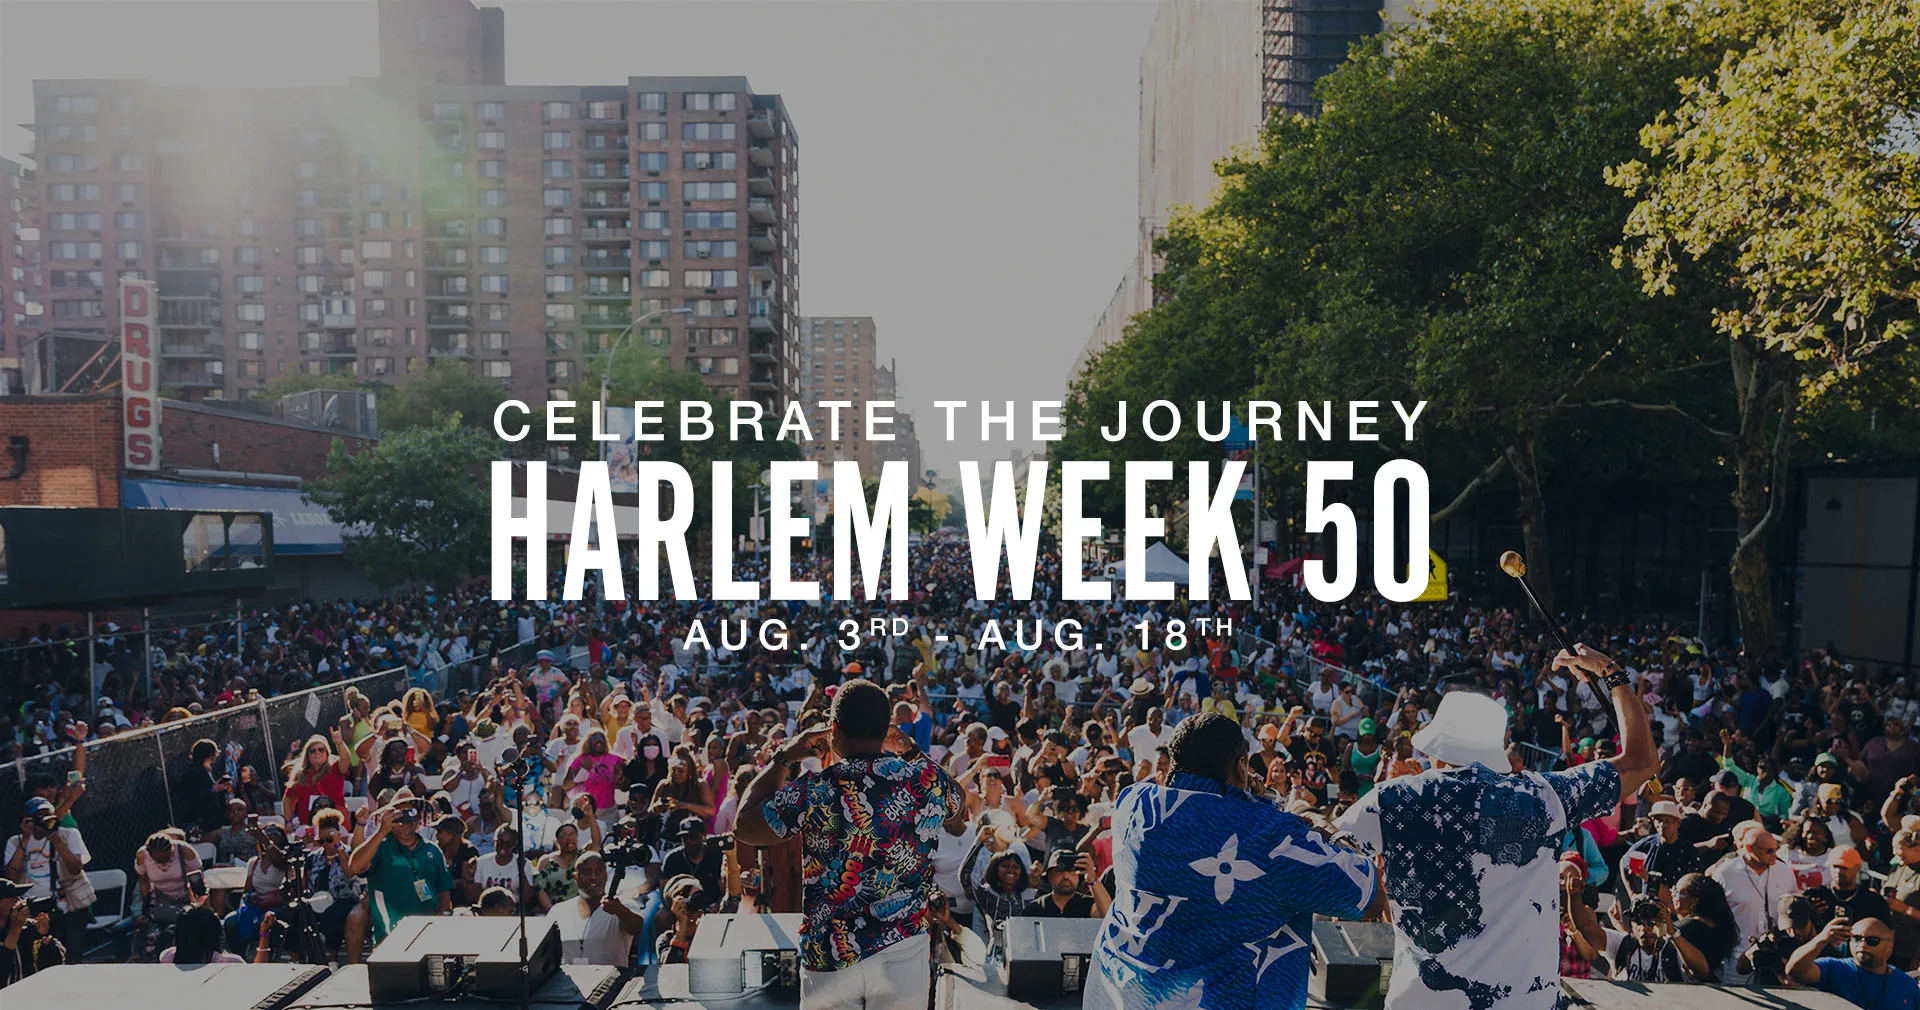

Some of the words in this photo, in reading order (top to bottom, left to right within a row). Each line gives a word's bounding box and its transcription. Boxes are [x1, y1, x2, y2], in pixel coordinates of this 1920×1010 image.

[124, 285, 152, 465] DRUGS
[838, 779, 873, 831] WHACK!
[884, 787, 916, 822] BANG!
[886, 842, 918, 871] BANG!
